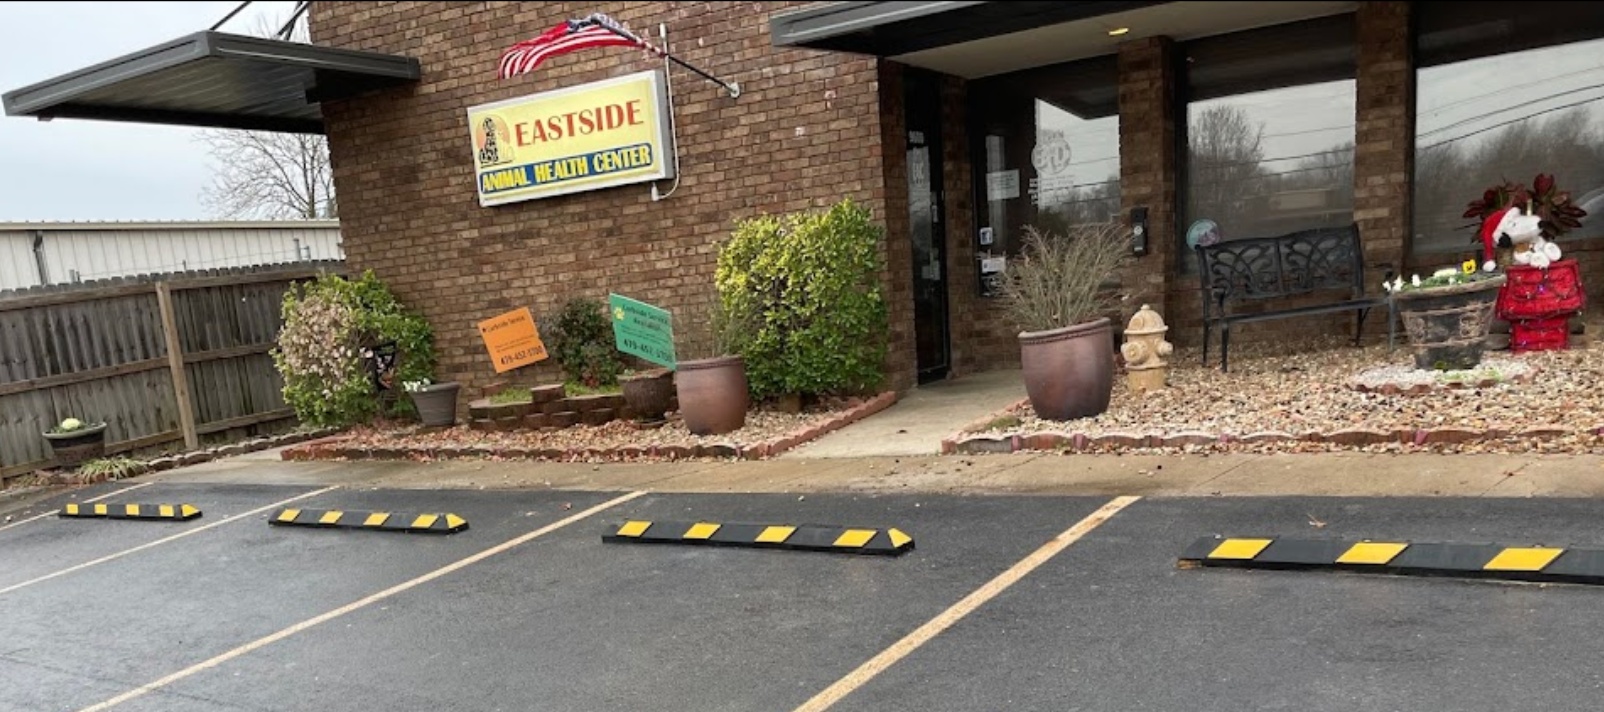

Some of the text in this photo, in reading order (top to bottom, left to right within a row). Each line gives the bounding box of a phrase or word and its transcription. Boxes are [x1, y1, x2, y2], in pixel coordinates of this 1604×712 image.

[514, 99, 644, 147] EASTSIDE
[482, 146, 651, 191] ANIMAL HEALTH CENTER
